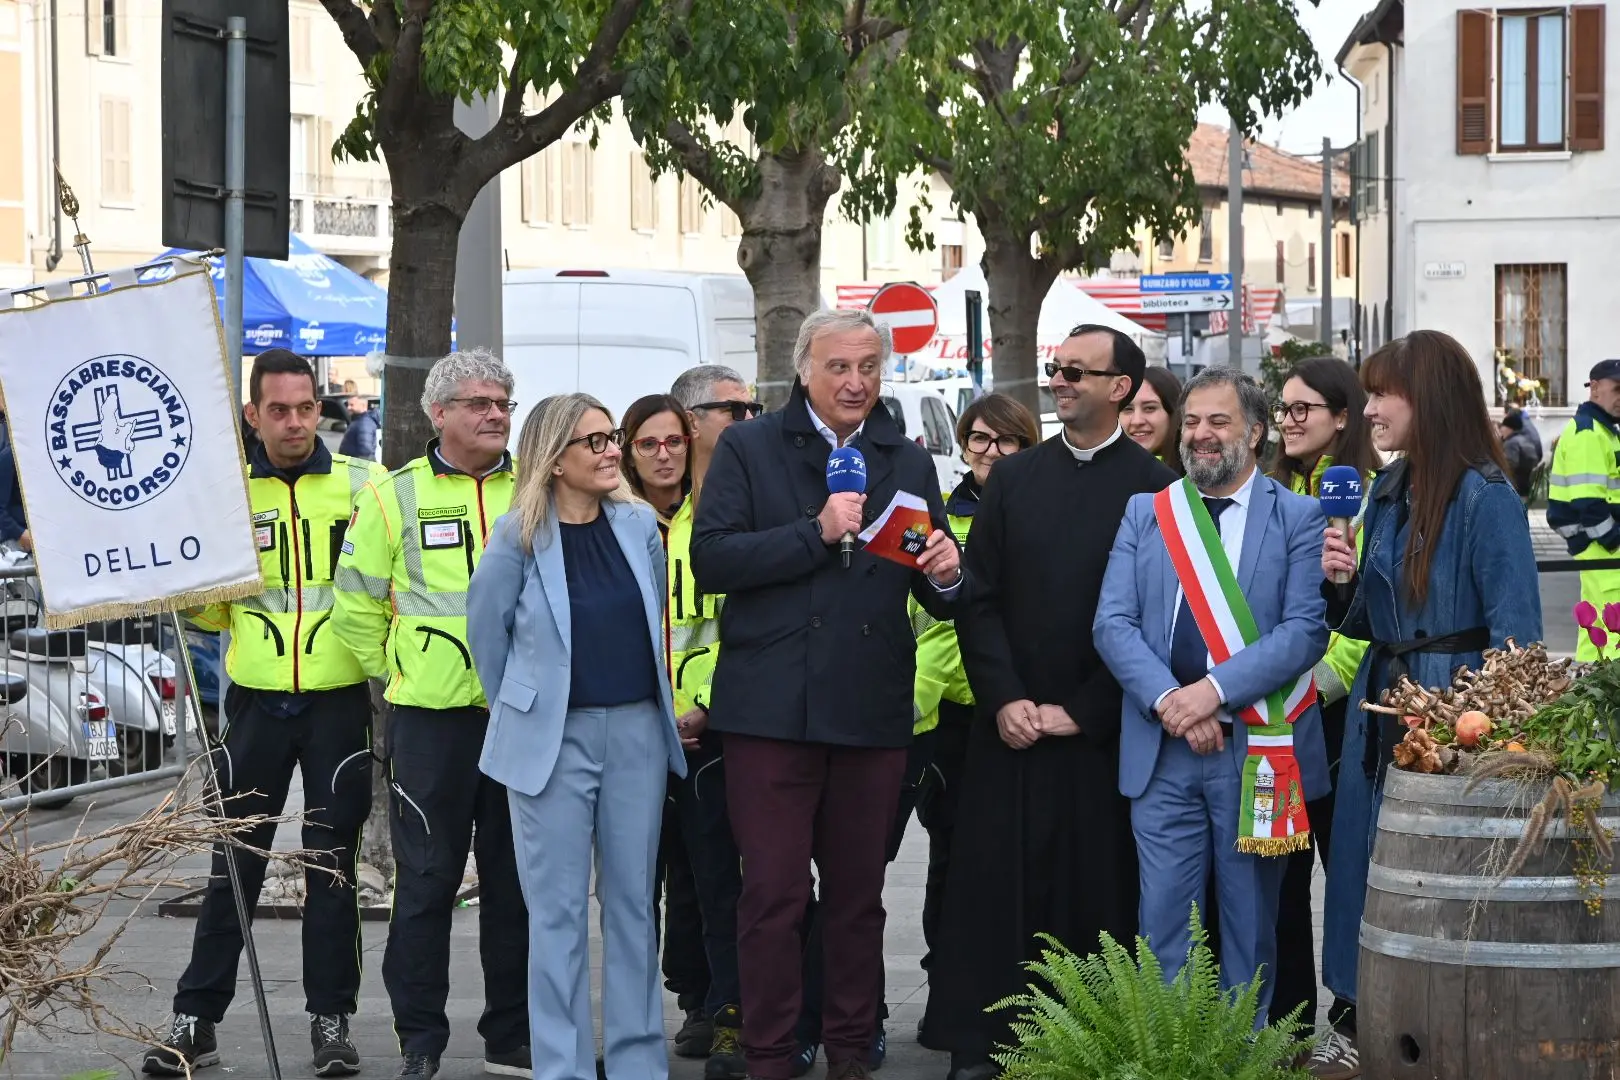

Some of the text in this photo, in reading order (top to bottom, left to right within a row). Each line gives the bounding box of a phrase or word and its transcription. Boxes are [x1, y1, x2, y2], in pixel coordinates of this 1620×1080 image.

[1142, 278, 1211, 289] QUINZANO D'OGLIO
[1143, 299, 1189, 308] biblioteca
[51, 360, 185, 451] BASSABRESCIANA
[70, 452, 181, 505] SOCCORSO
[84, 535, 201, 578] DELLO
[904, 541, 921, 553] NOI
